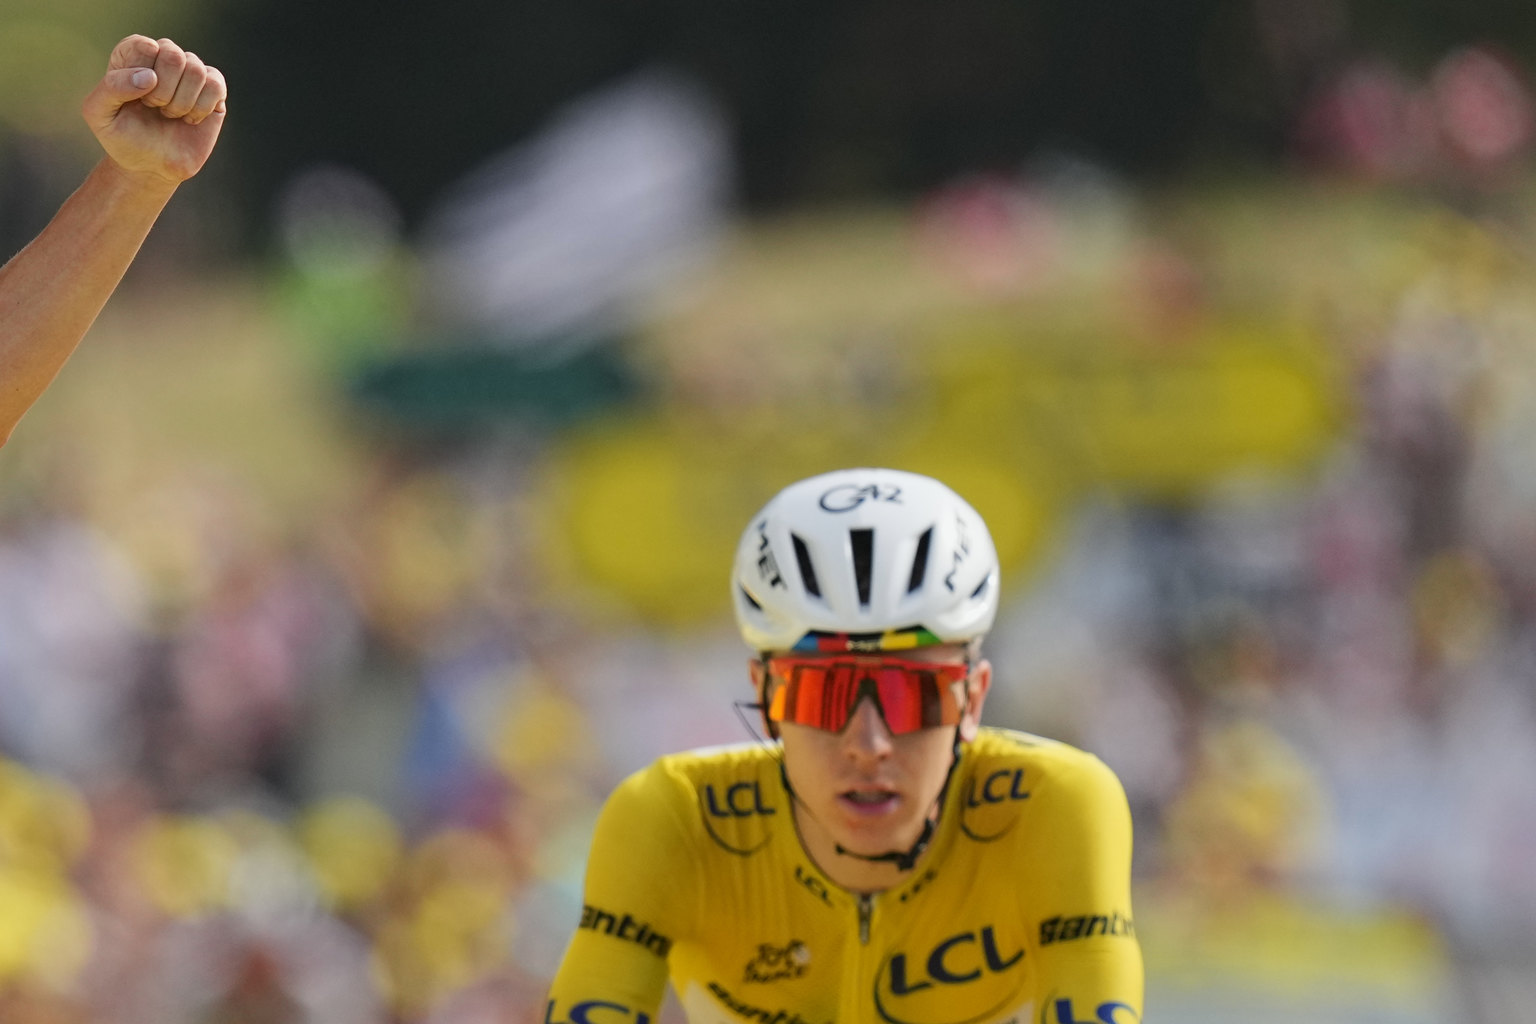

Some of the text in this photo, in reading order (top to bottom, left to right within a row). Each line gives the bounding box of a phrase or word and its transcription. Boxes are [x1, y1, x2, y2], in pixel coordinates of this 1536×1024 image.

[706, 781, 776, 817] LCL
[967, 769, 1031, 808] LCL
[891, 924, 1025, 996] LCL
